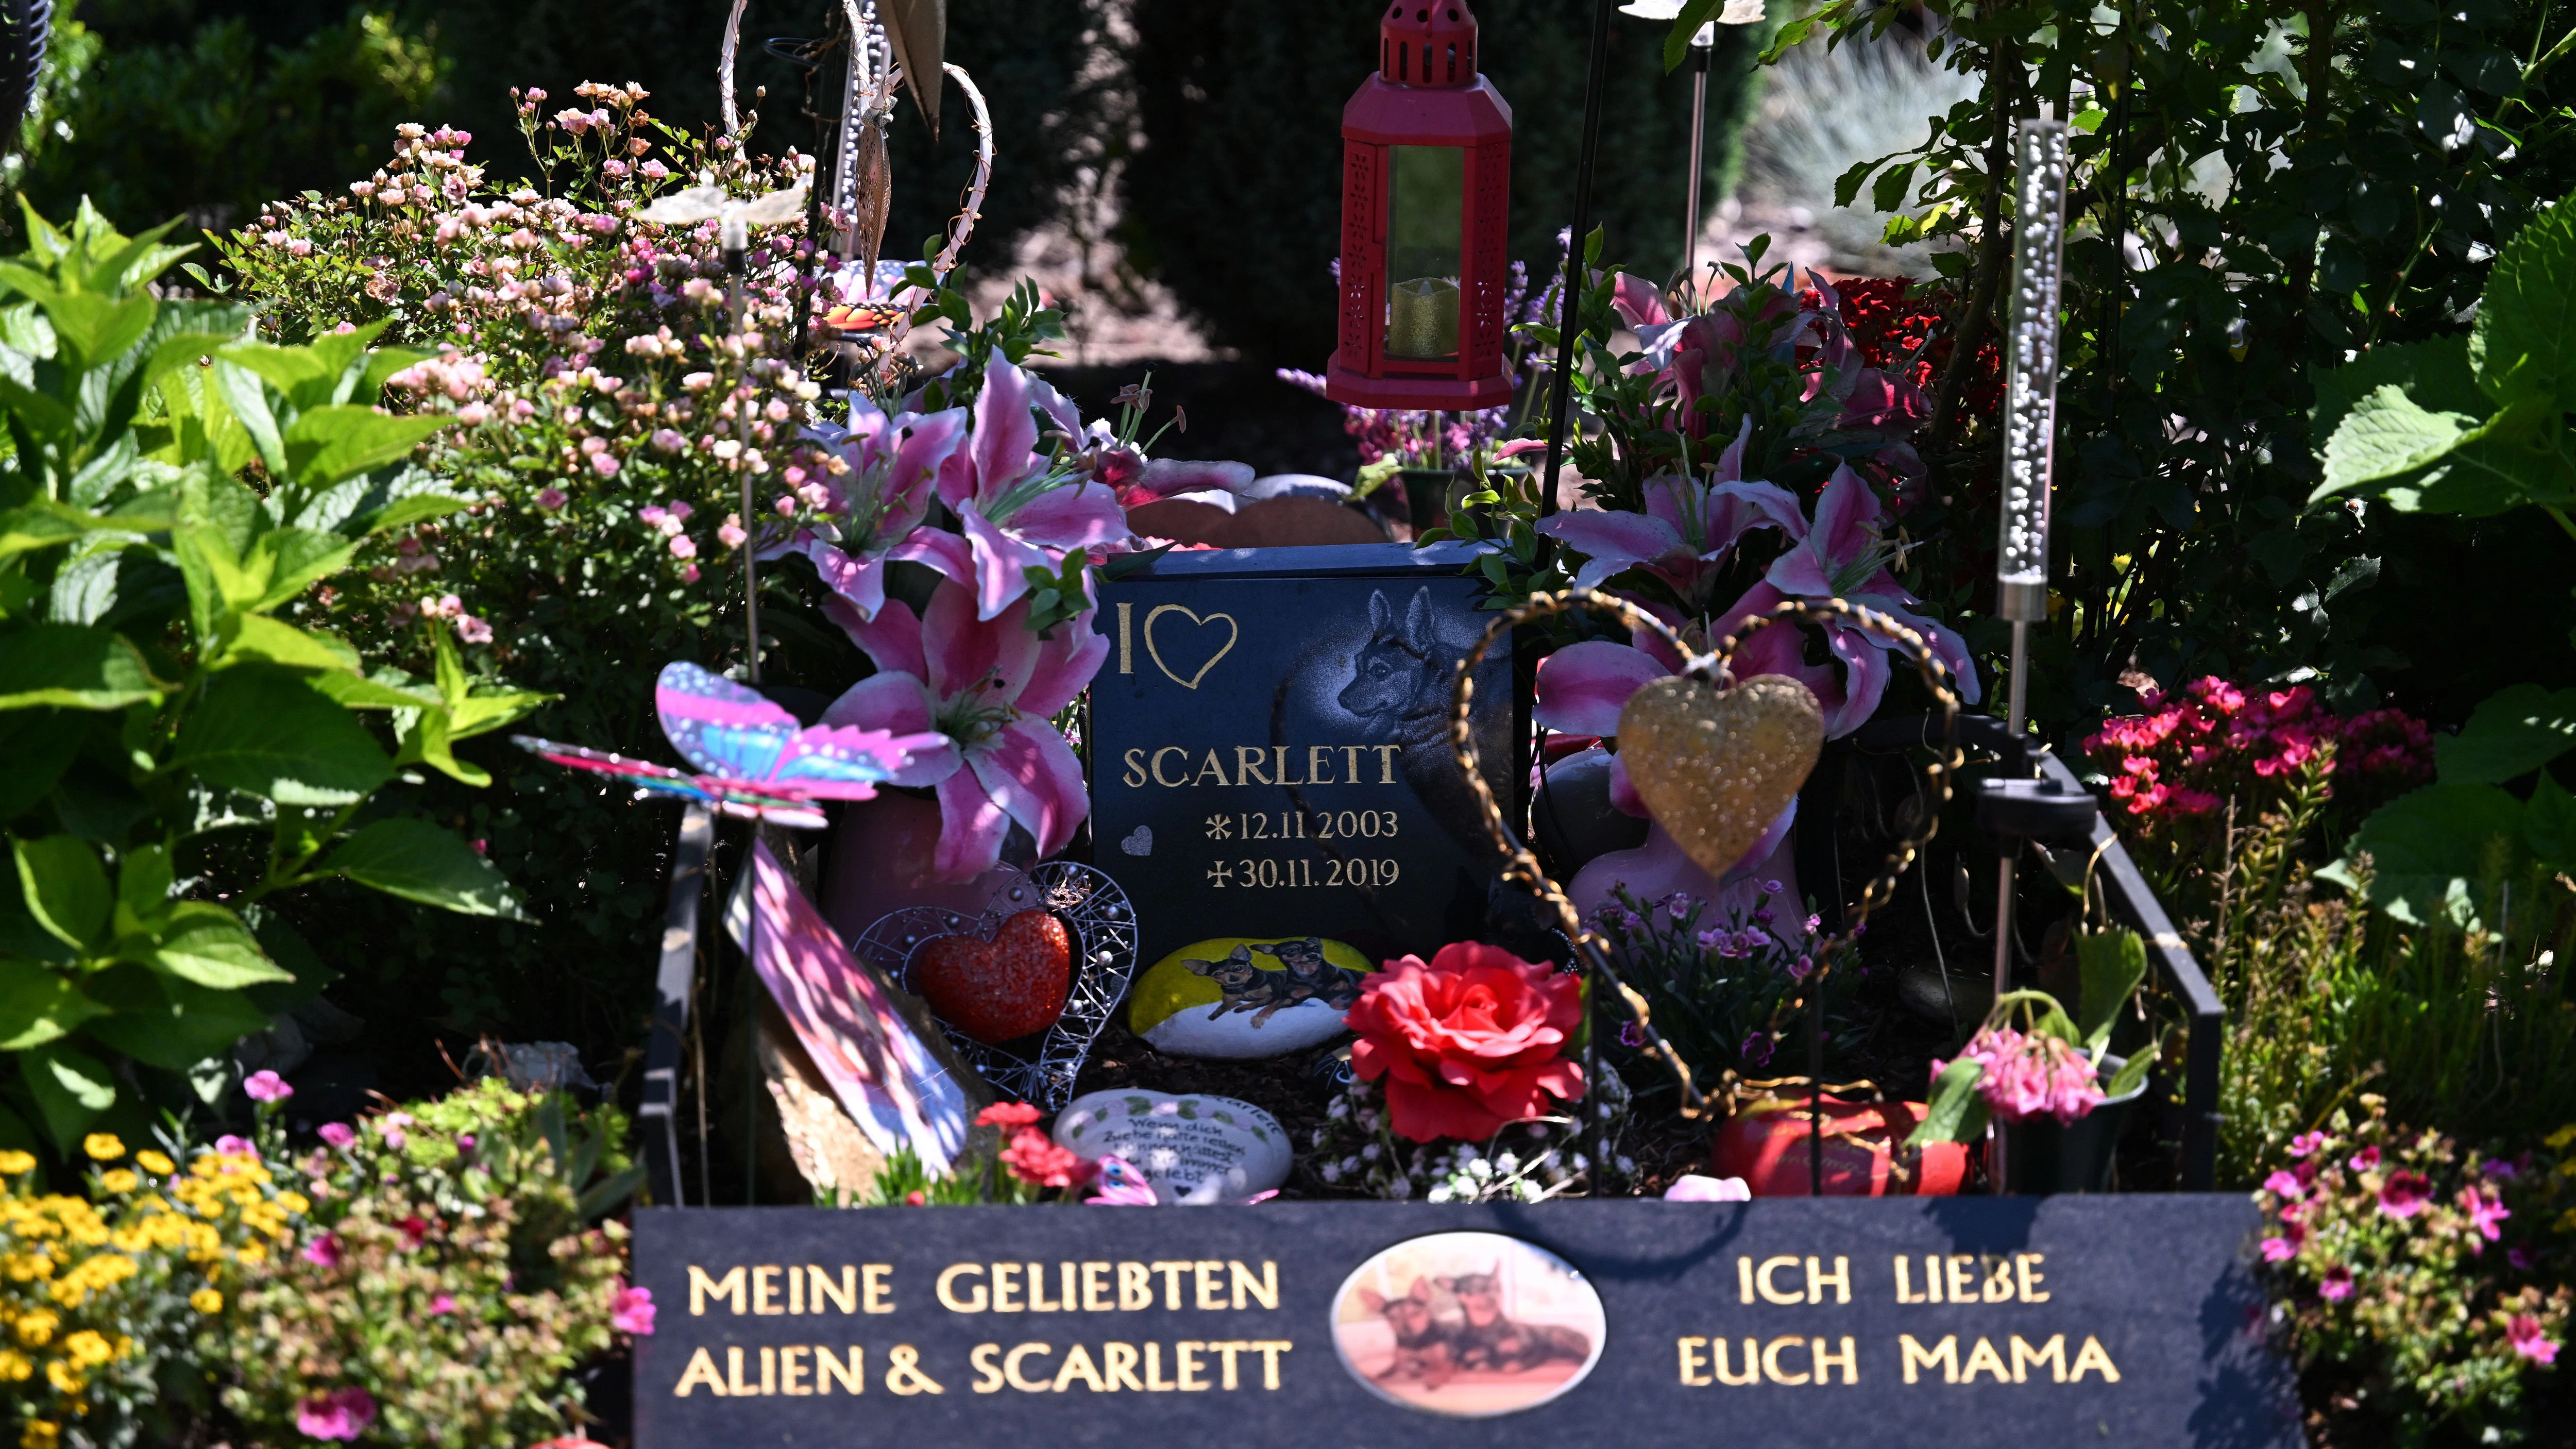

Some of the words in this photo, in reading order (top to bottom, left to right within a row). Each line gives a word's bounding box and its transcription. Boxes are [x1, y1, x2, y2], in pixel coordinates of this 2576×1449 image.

[1116, 602, 1134, 674] I
[1123, 744, 1402, 788] SCARLETT
[1185, 1120, 1223, 1136] dich
[687, 1263, 896, 1317] MEINE
[936, 1259, 1280, 1314] GELIEBTEN
[1737, 1255, 1852, 1305] ICH
[1893, 1252, 2052, 1304] LIEBE
[673, 1344, 865, 1398] ALIEN
[885, 1343, 945, 1396] &
[970, 1339, 1293, 1394] SCARLETT
[1676, 1335, 1859, 1387] EUCH
[1898, 1333, 2122, 1385] MAMA
